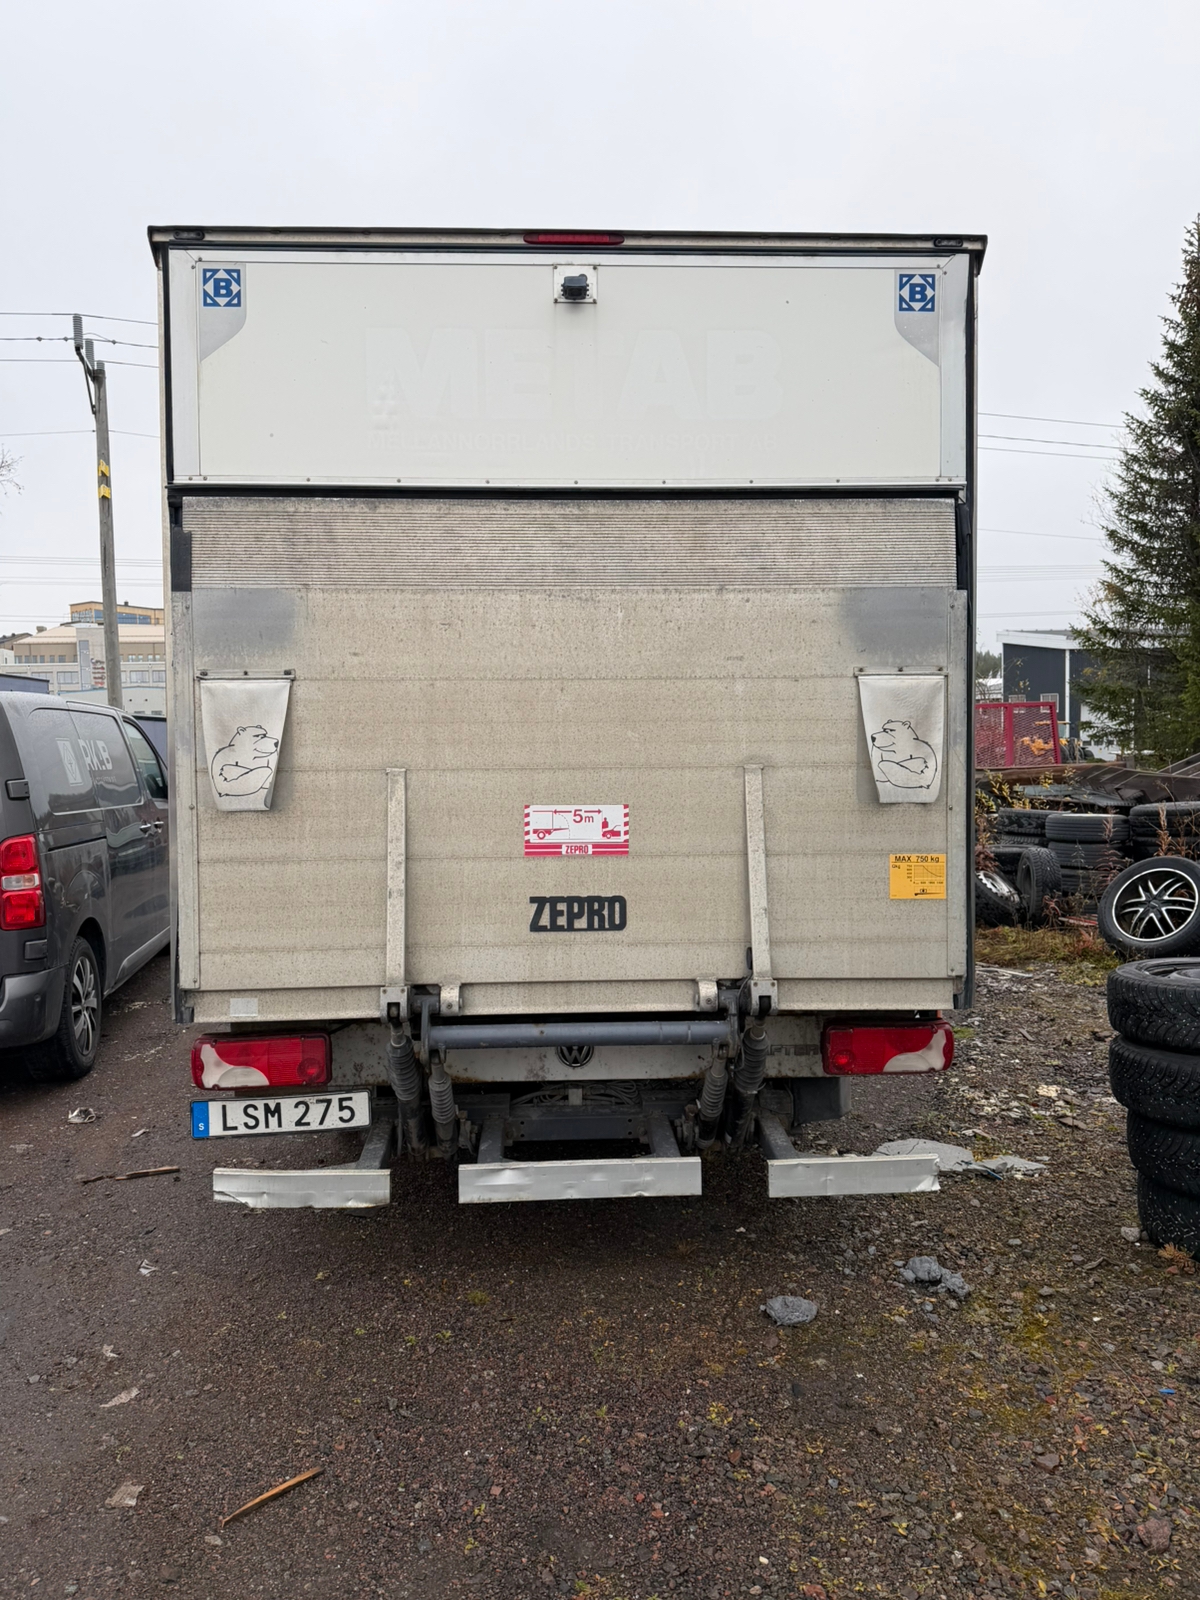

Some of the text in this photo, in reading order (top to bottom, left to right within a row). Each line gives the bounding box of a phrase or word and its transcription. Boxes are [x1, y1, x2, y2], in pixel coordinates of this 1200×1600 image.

[565, 845, 589, 854] ZEPRO
[529, 895, 627, 932] ZEPRO
[198, 1096, 355, 1131] S LSM 275
